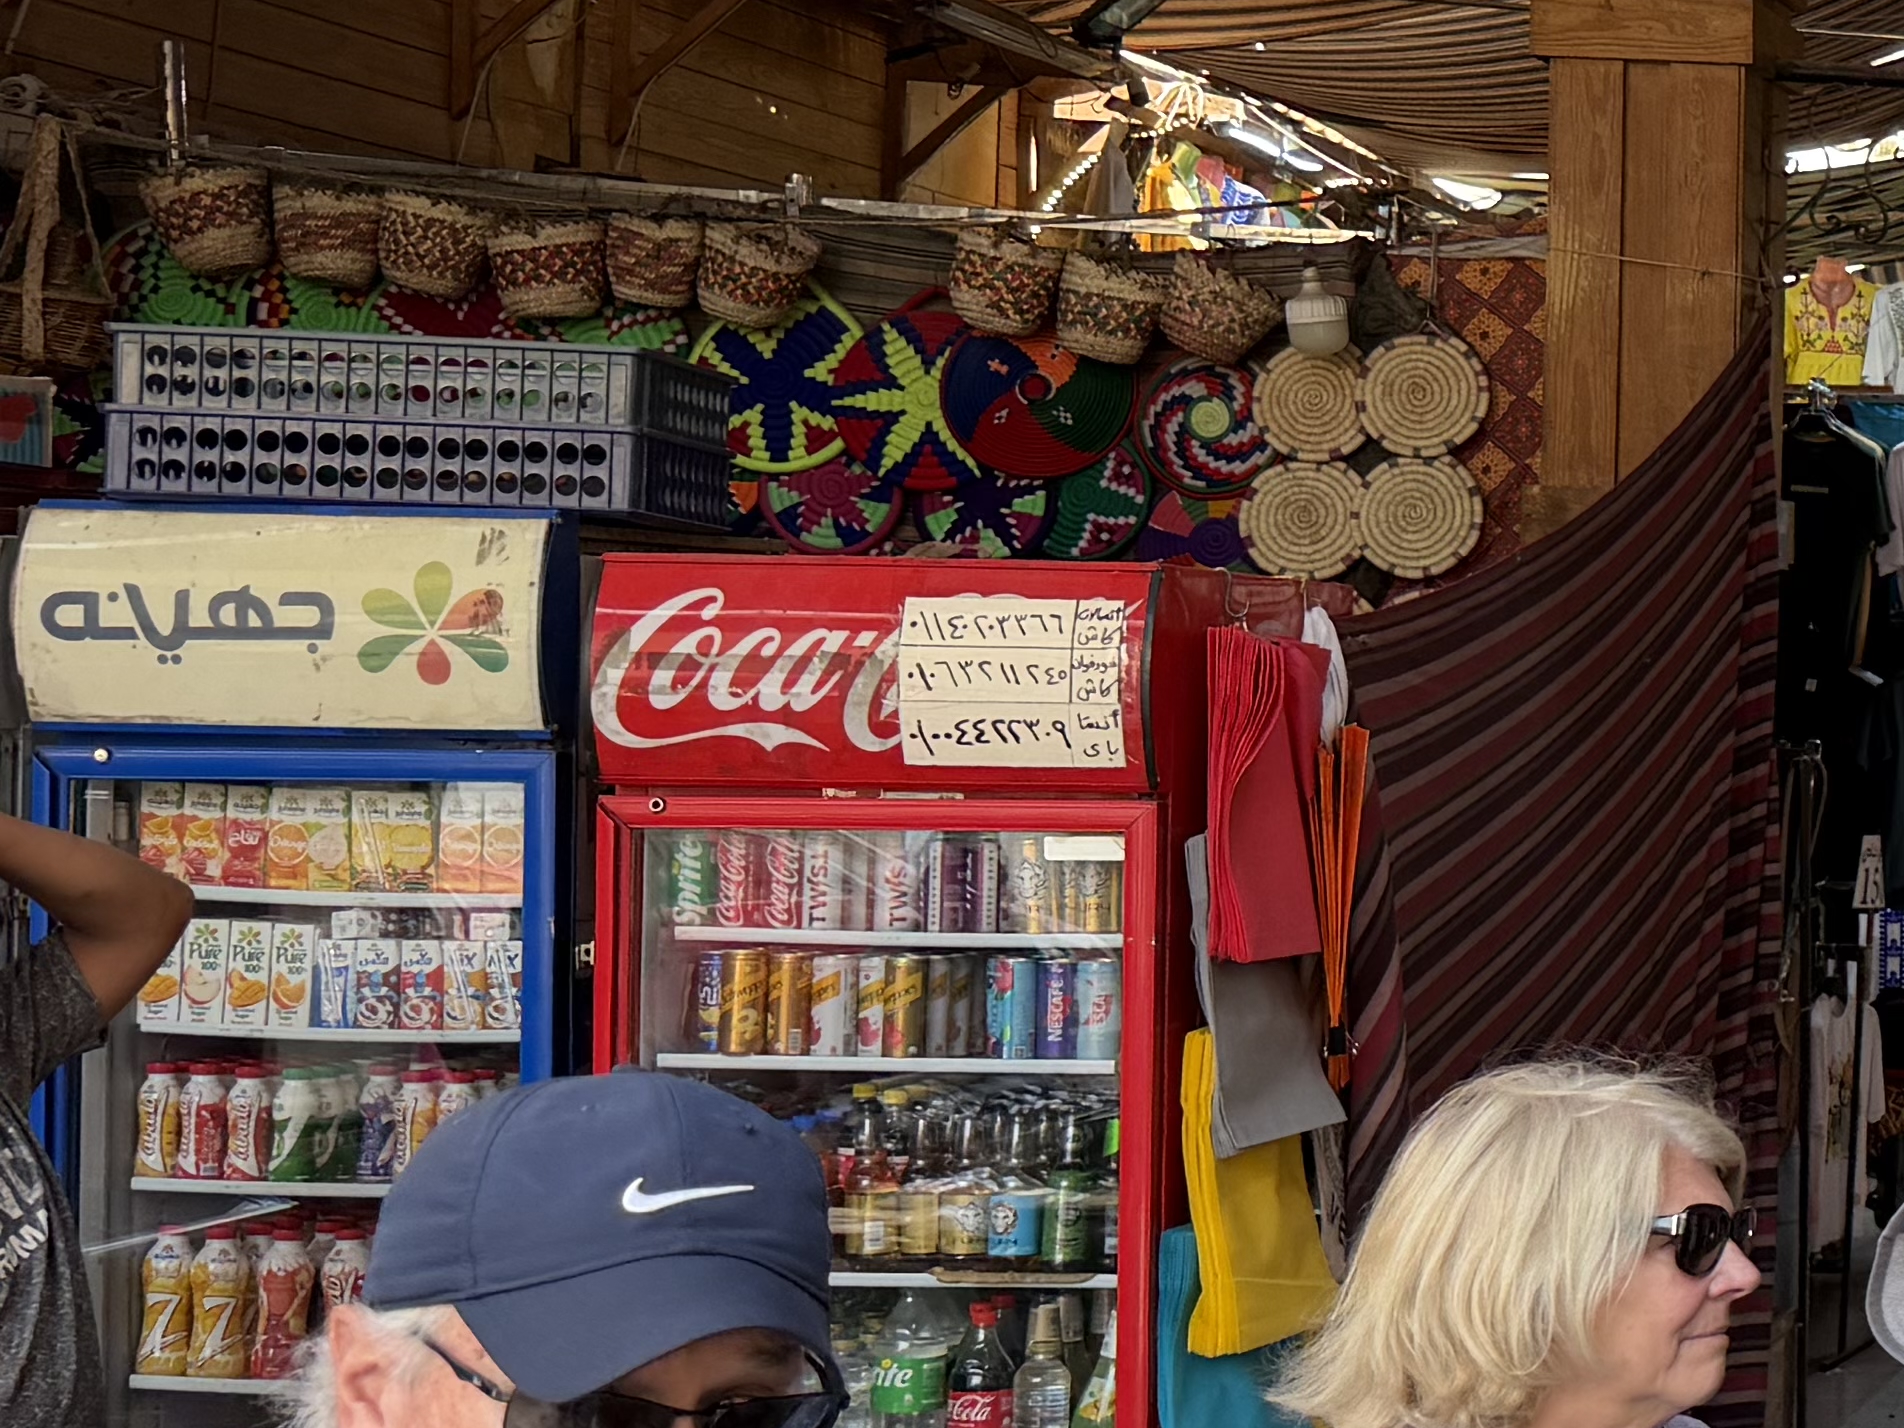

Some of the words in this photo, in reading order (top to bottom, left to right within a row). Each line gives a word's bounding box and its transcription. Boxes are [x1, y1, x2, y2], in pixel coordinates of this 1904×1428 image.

[673, 834, 703, 925] Sprite
[188, 941, 222, 959] Pure
[232, 944, 266, 963] Pure
[275, 946, 308, 964] Pure
